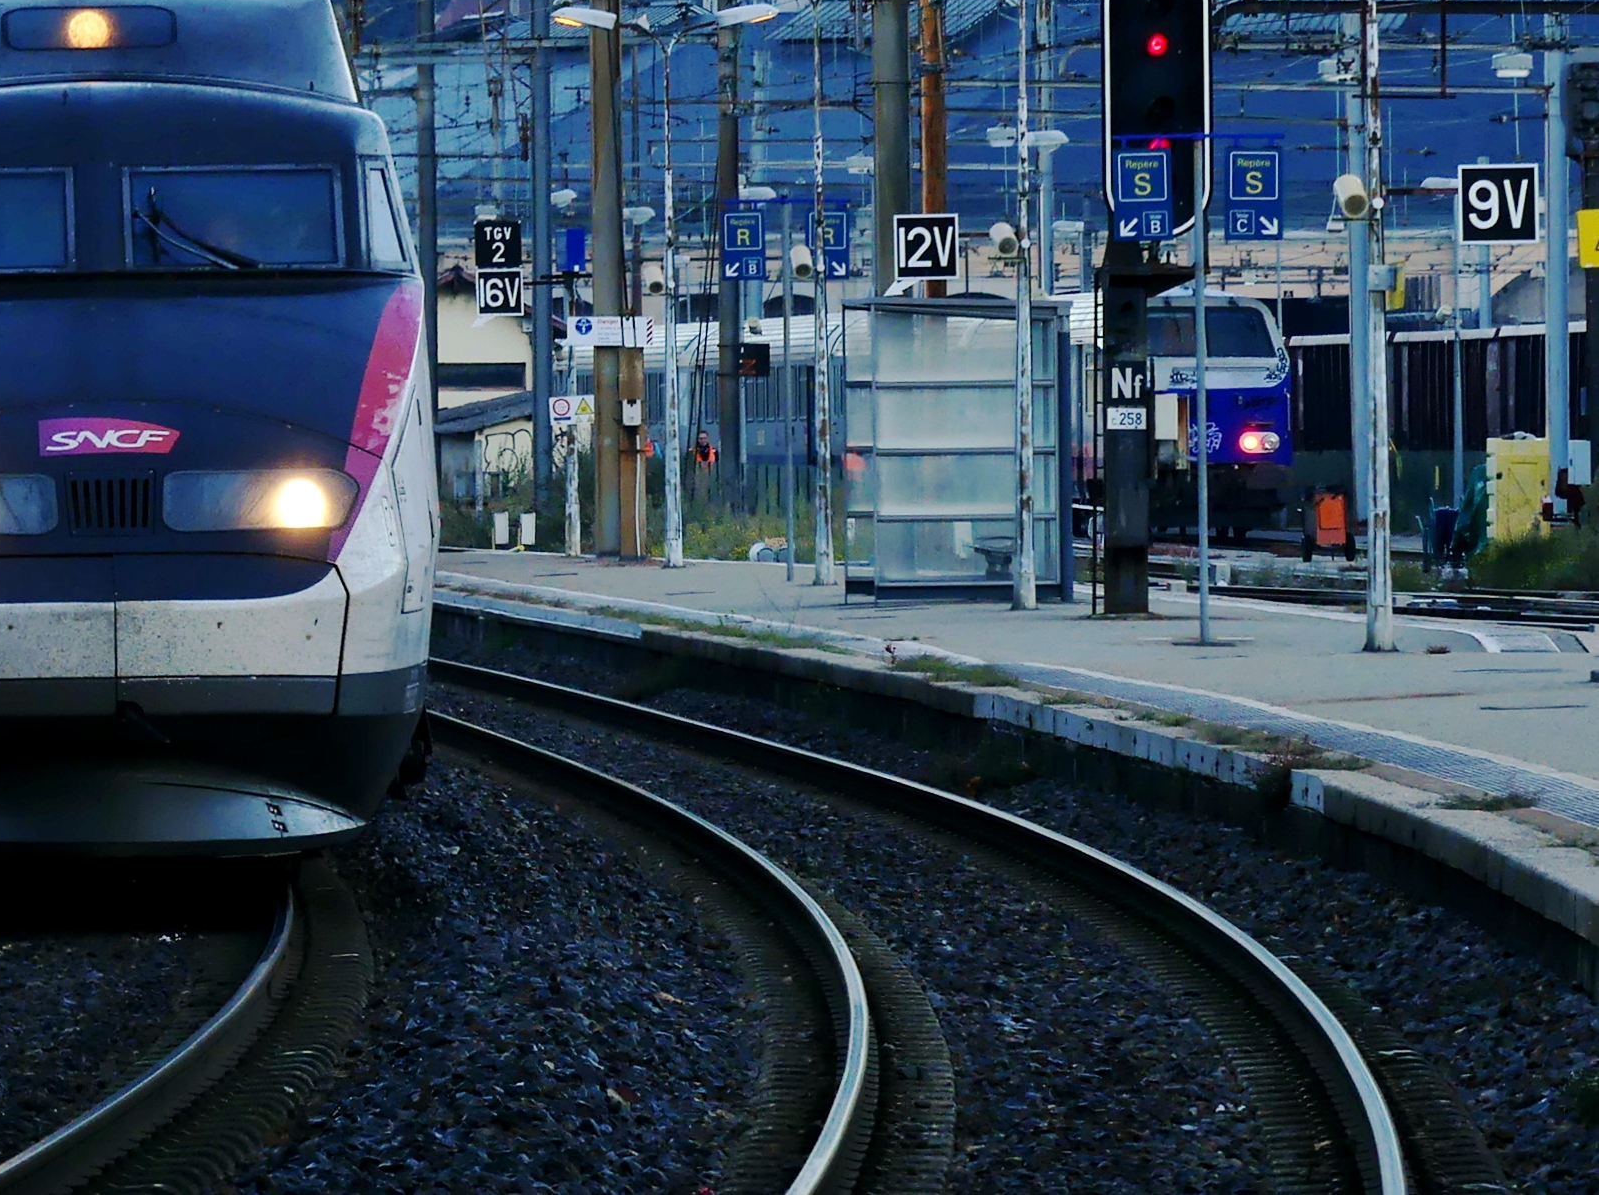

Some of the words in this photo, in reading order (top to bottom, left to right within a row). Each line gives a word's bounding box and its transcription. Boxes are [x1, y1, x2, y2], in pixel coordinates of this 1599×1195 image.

[1133, 172, 1151, 195] S
[1245, 170, 1264, 194] S
[1468, 178, 1529, 229] 9V
[483, 226, 512, 241] TGV
[1149, 220, 1161, 234] B
[1234, 219, 1247, 232] C
[736, 228, 750, 246] R
[898, 226, 954, 268] 12V
[491, 241, 506, 263] 2
[479, 277, 520, 308] 16V
[1111, 367, 1144, 399] Nf
[45, 429, 170, 451] SNCF
